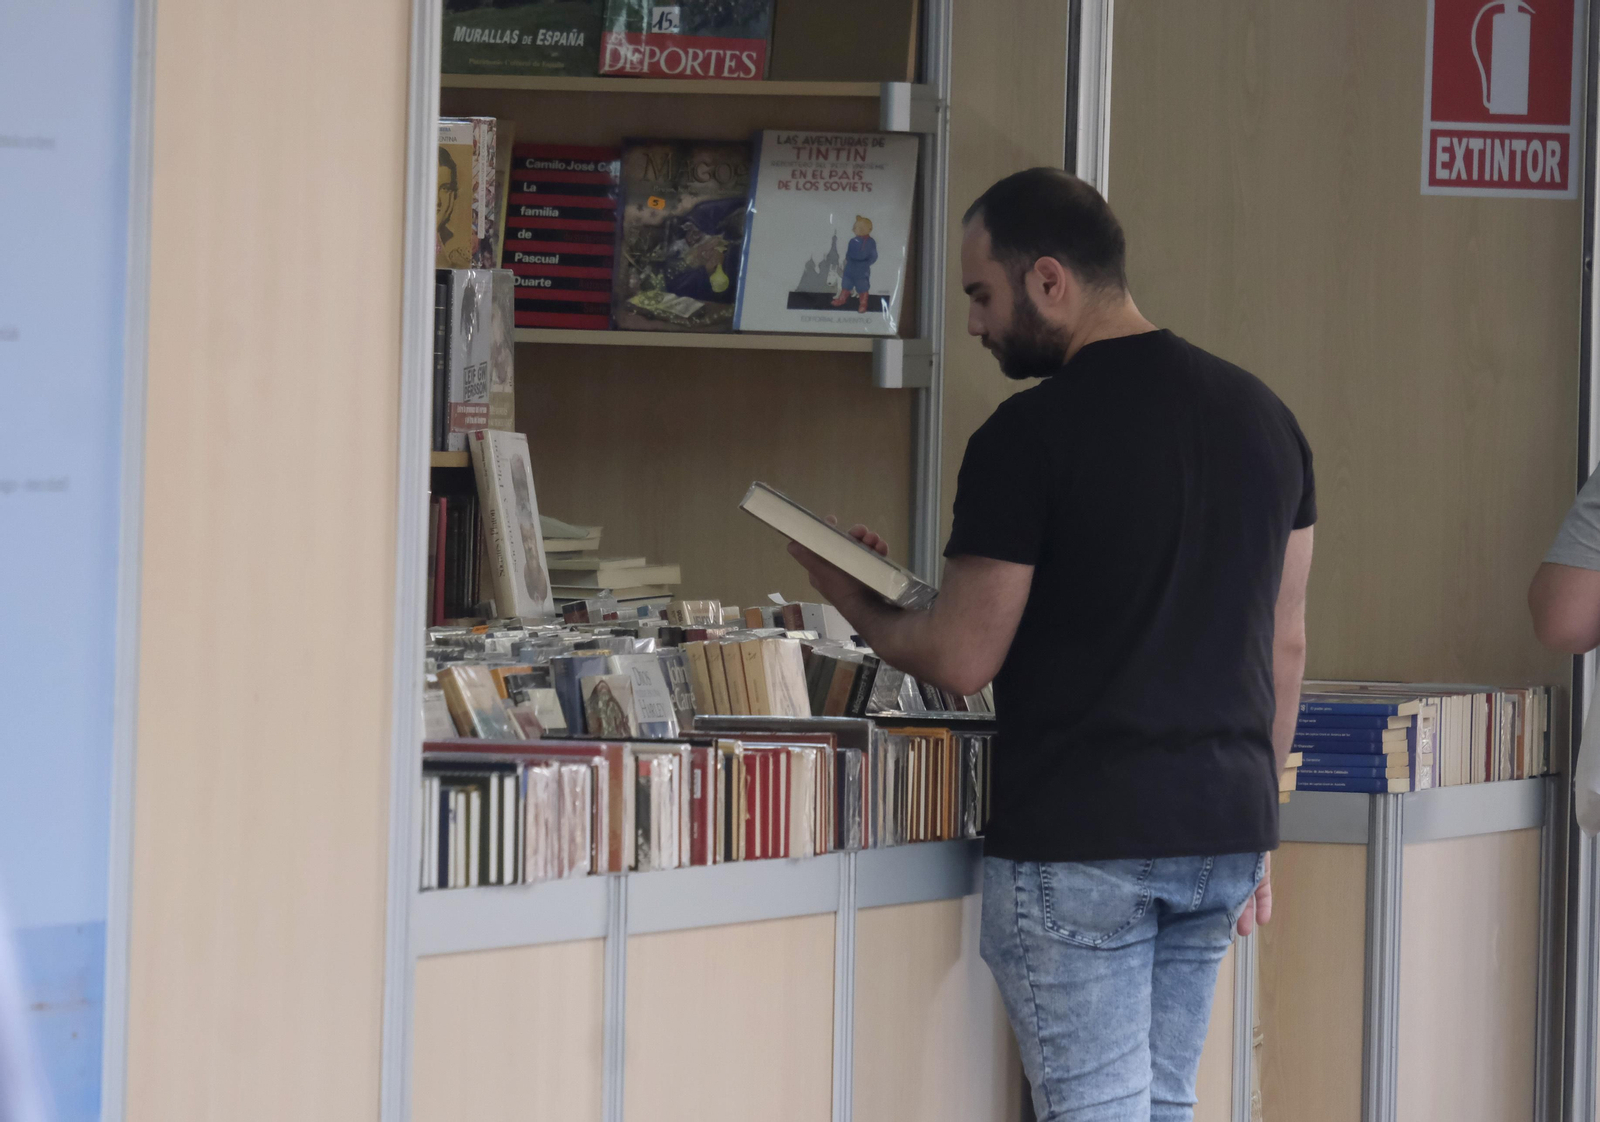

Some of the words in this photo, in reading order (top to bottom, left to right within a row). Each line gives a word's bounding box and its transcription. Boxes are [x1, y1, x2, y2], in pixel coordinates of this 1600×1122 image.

[453, 26, 520, 45] MURALLAS
[522, 35, 534, 45] DE
[536, 28, 585, 47] ESPAÑA
[604, 44, 757, 78] DEPORTES
[776, 134, 799, 146] LAS
[801, 135, 869, 148] AVENTURAS
[871, 137, 886, 148] DE
[792, 146, 868, 162] TINTIN
[1435, 136, 1562, 183] EXTINTOR
[525, 158, 566, 171] Camilo
[566, 160, 595, 172] José
[791, 169, 807, 180] EN
[811, 169, 826, 180] EL
[523, 182, 537, 193] La
[777, 180, 791, 191] DE
[795, 180, 820, 192] LOS
[823, 181, 873, 193] SOVIETS
[520, 205, 560, 218] familia
[517, 228, 533, 240] de
[514, 252, 560, 265] Pascual
[513, 275, 552, 288] Duarte
[463, 367, 476, 386] LEIF
[666, 659, 688, 692] John
